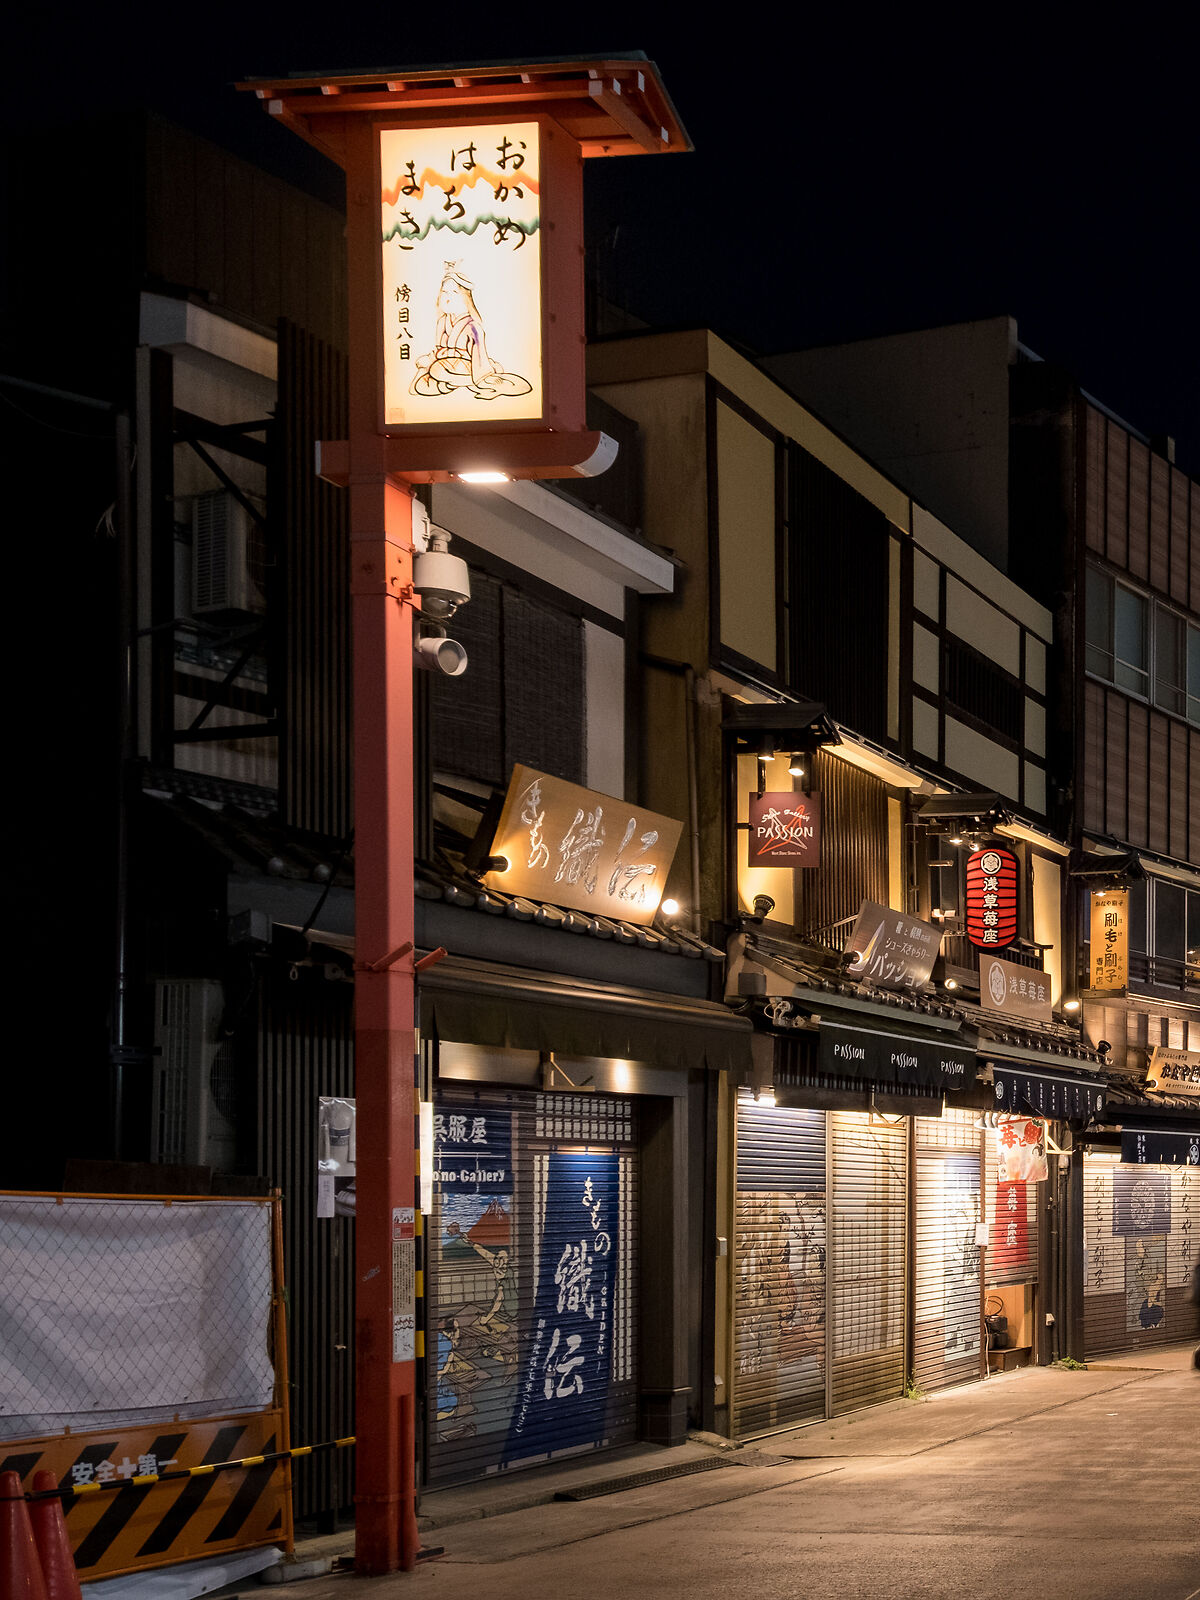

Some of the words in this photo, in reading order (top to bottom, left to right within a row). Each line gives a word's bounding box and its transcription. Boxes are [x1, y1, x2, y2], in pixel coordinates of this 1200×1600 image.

[397, 159, 421, 251] まき
[442, 141, 477, 221] はち
[494, 136, 527, 251] おかめ
[394, 283, 413, 361] 傍目八目
[757, 825, 814, 840] PASSION
[982, 876, 999, 943] 浅草苺座
[869, 952, 930, 988] パッション
[1104, 912, 1118, 983] 刷毛と刷子
[1009, 976, 1046, 1002] 浅草苺座
[834, 1044, 865, 1061] PASSION
[890, 1053, 918, 1068] PASSION
[940, 1061, 965, 1075] PASSION
